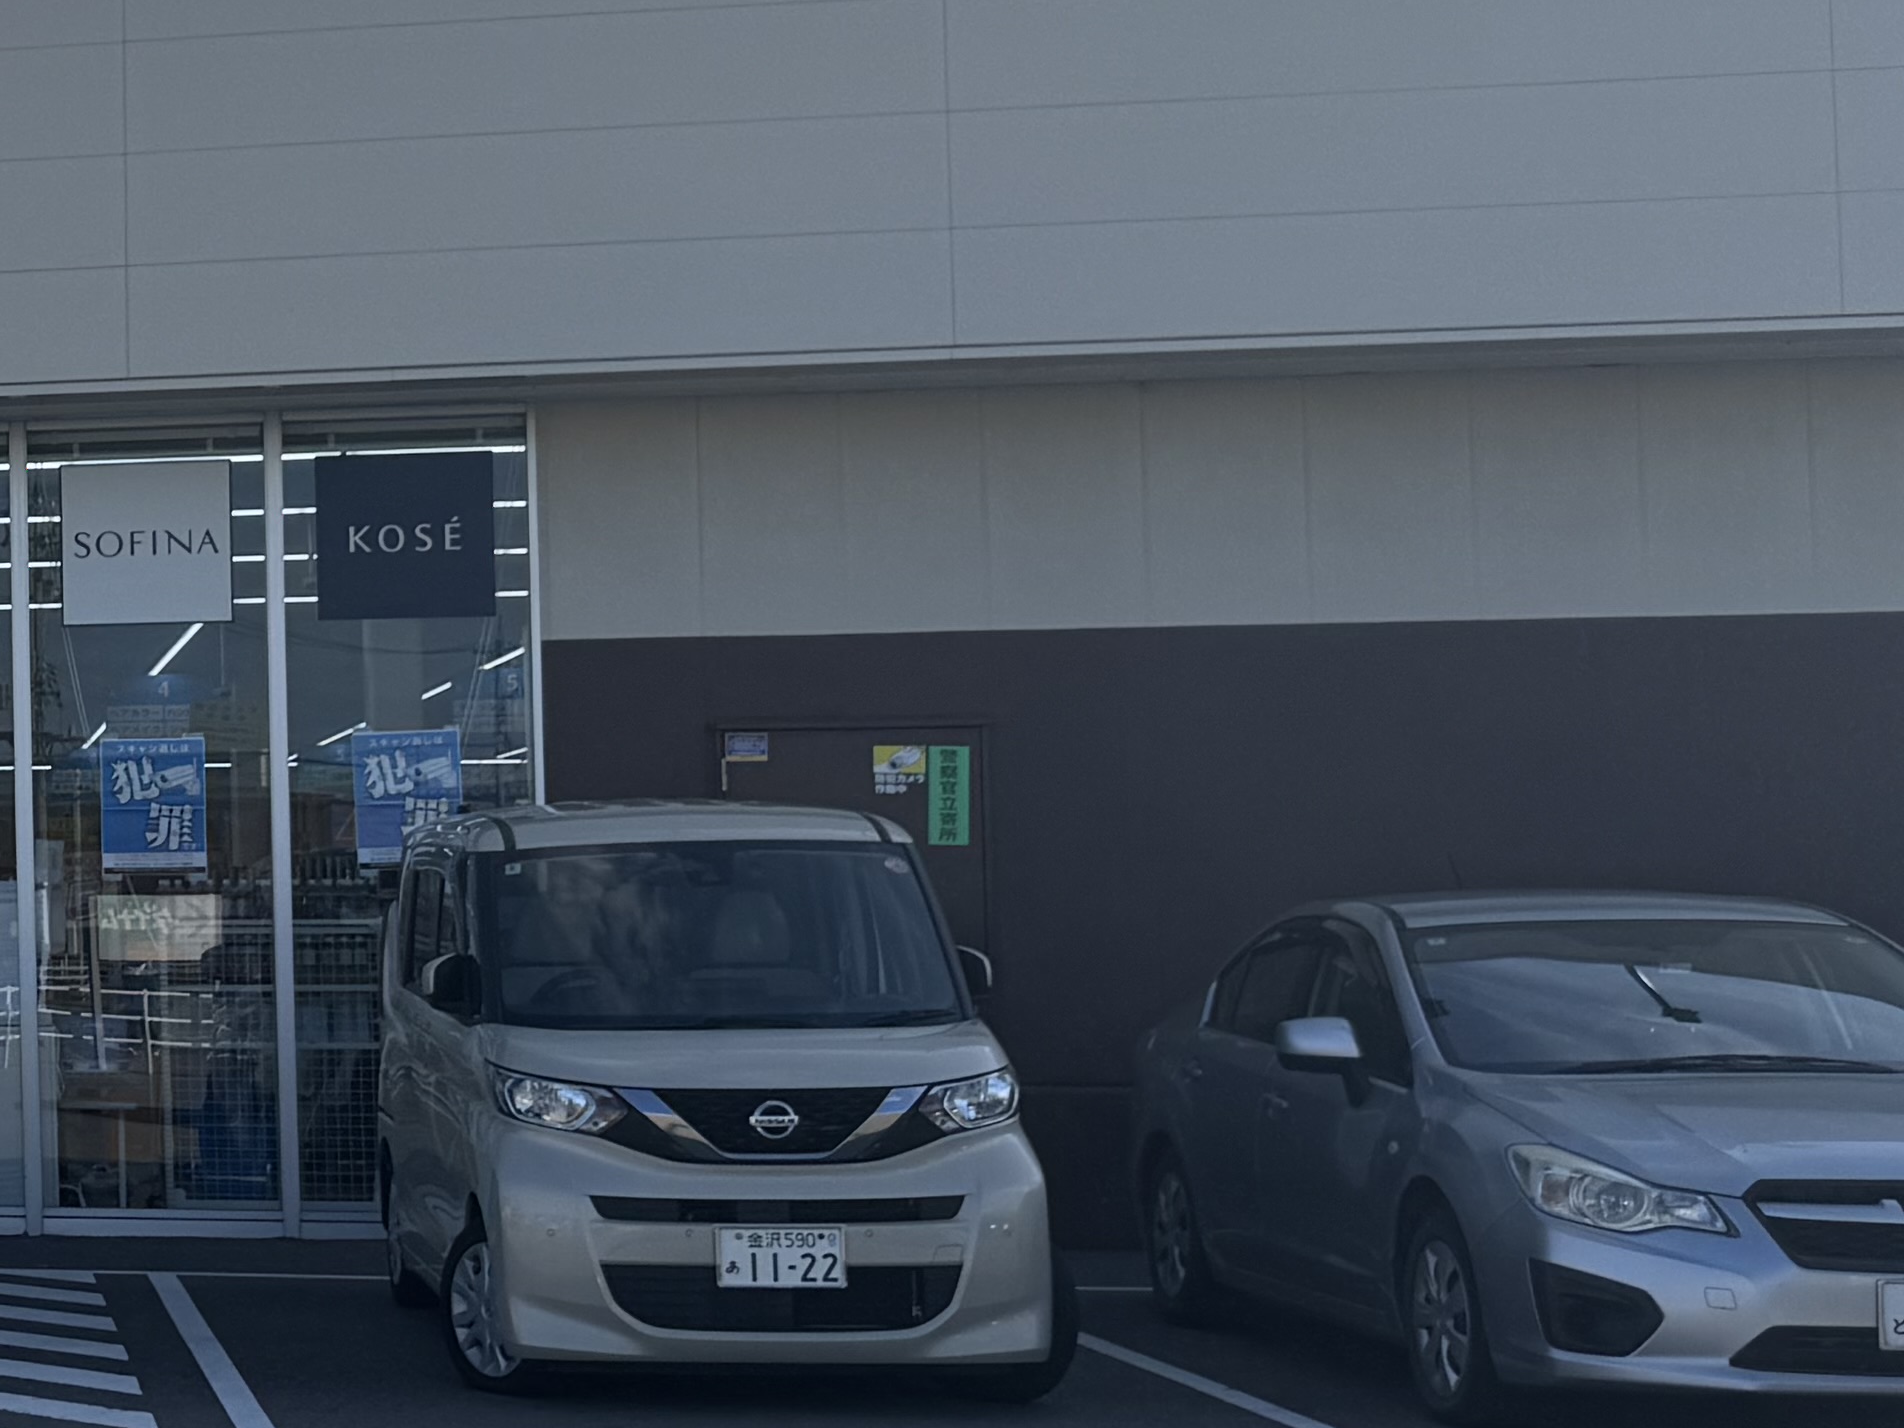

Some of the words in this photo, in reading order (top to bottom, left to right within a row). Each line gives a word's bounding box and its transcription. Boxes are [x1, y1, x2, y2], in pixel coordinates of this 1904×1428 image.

[72, 528, 220, 560] SOFINA
[347, 516, 465, 554] KOSÉ
[157, 680, 170, 698] 4
[110, 755, 161, 805] 犯
[747, 1232, 817, 1248] 金沢590
[725, 1261, 740, 1274] あ
[750, 1252, 839, 1282] 11-22
